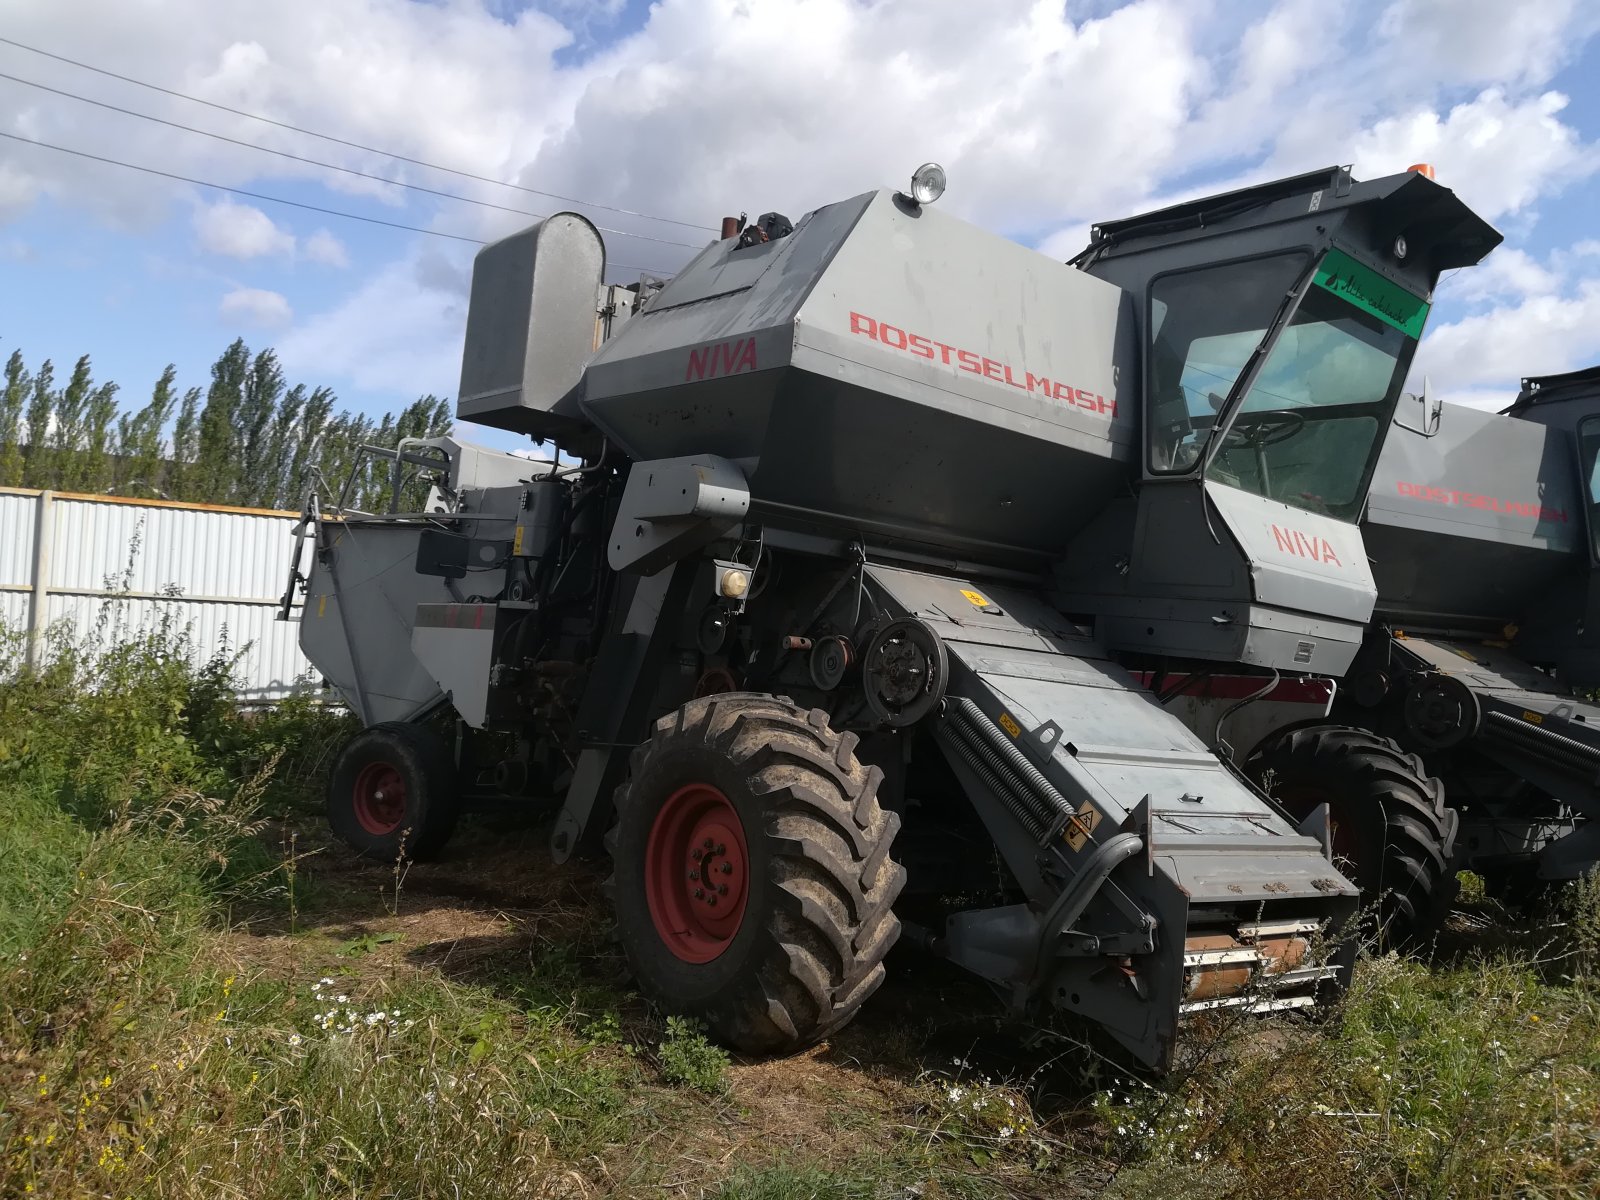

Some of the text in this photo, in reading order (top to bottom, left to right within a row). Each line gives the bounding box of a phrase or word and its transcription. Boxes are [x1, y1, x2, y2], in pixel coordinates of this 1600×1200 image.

[686, 336, 758, 382] NIVA
[849, 311, 1119, 419] ROSTSELMASH
[1271, 524, 1342, 567] NIVA
